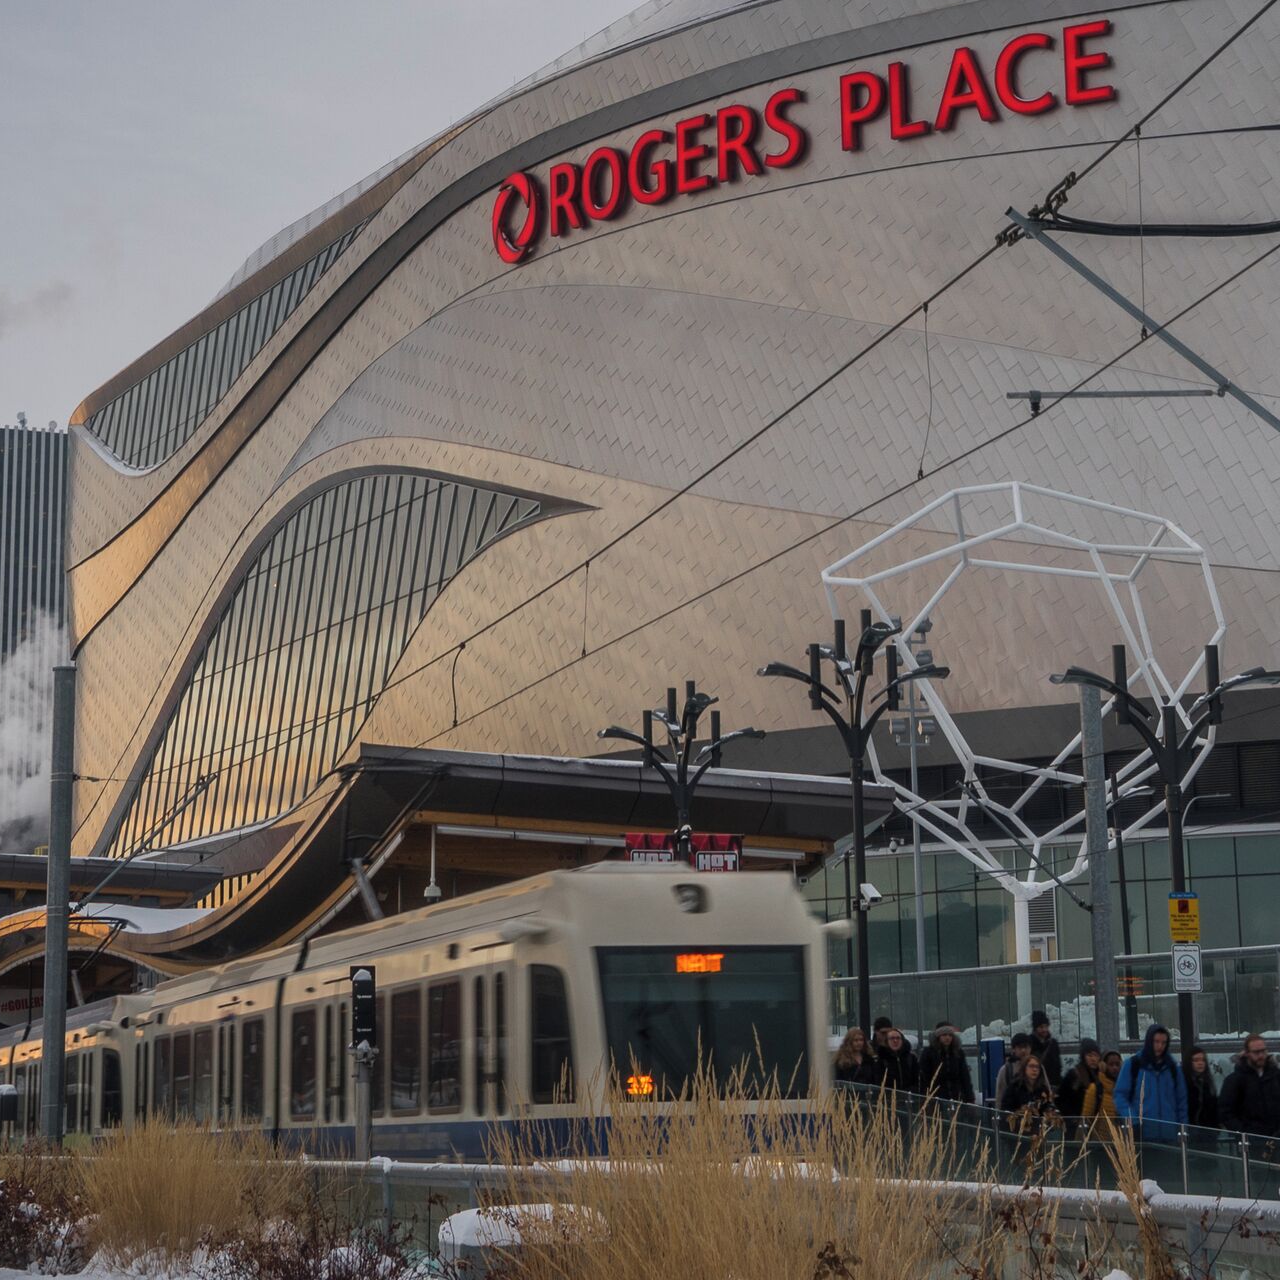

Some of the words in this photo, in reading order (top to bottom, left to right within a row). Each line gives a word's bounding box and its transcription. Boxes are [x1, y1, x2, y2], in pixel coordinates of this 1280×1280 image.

[548, 88, 807, 238] ROGERS
[839, 19, 1117, 152] PLACE
[698, 854, 737, 871] HOT
